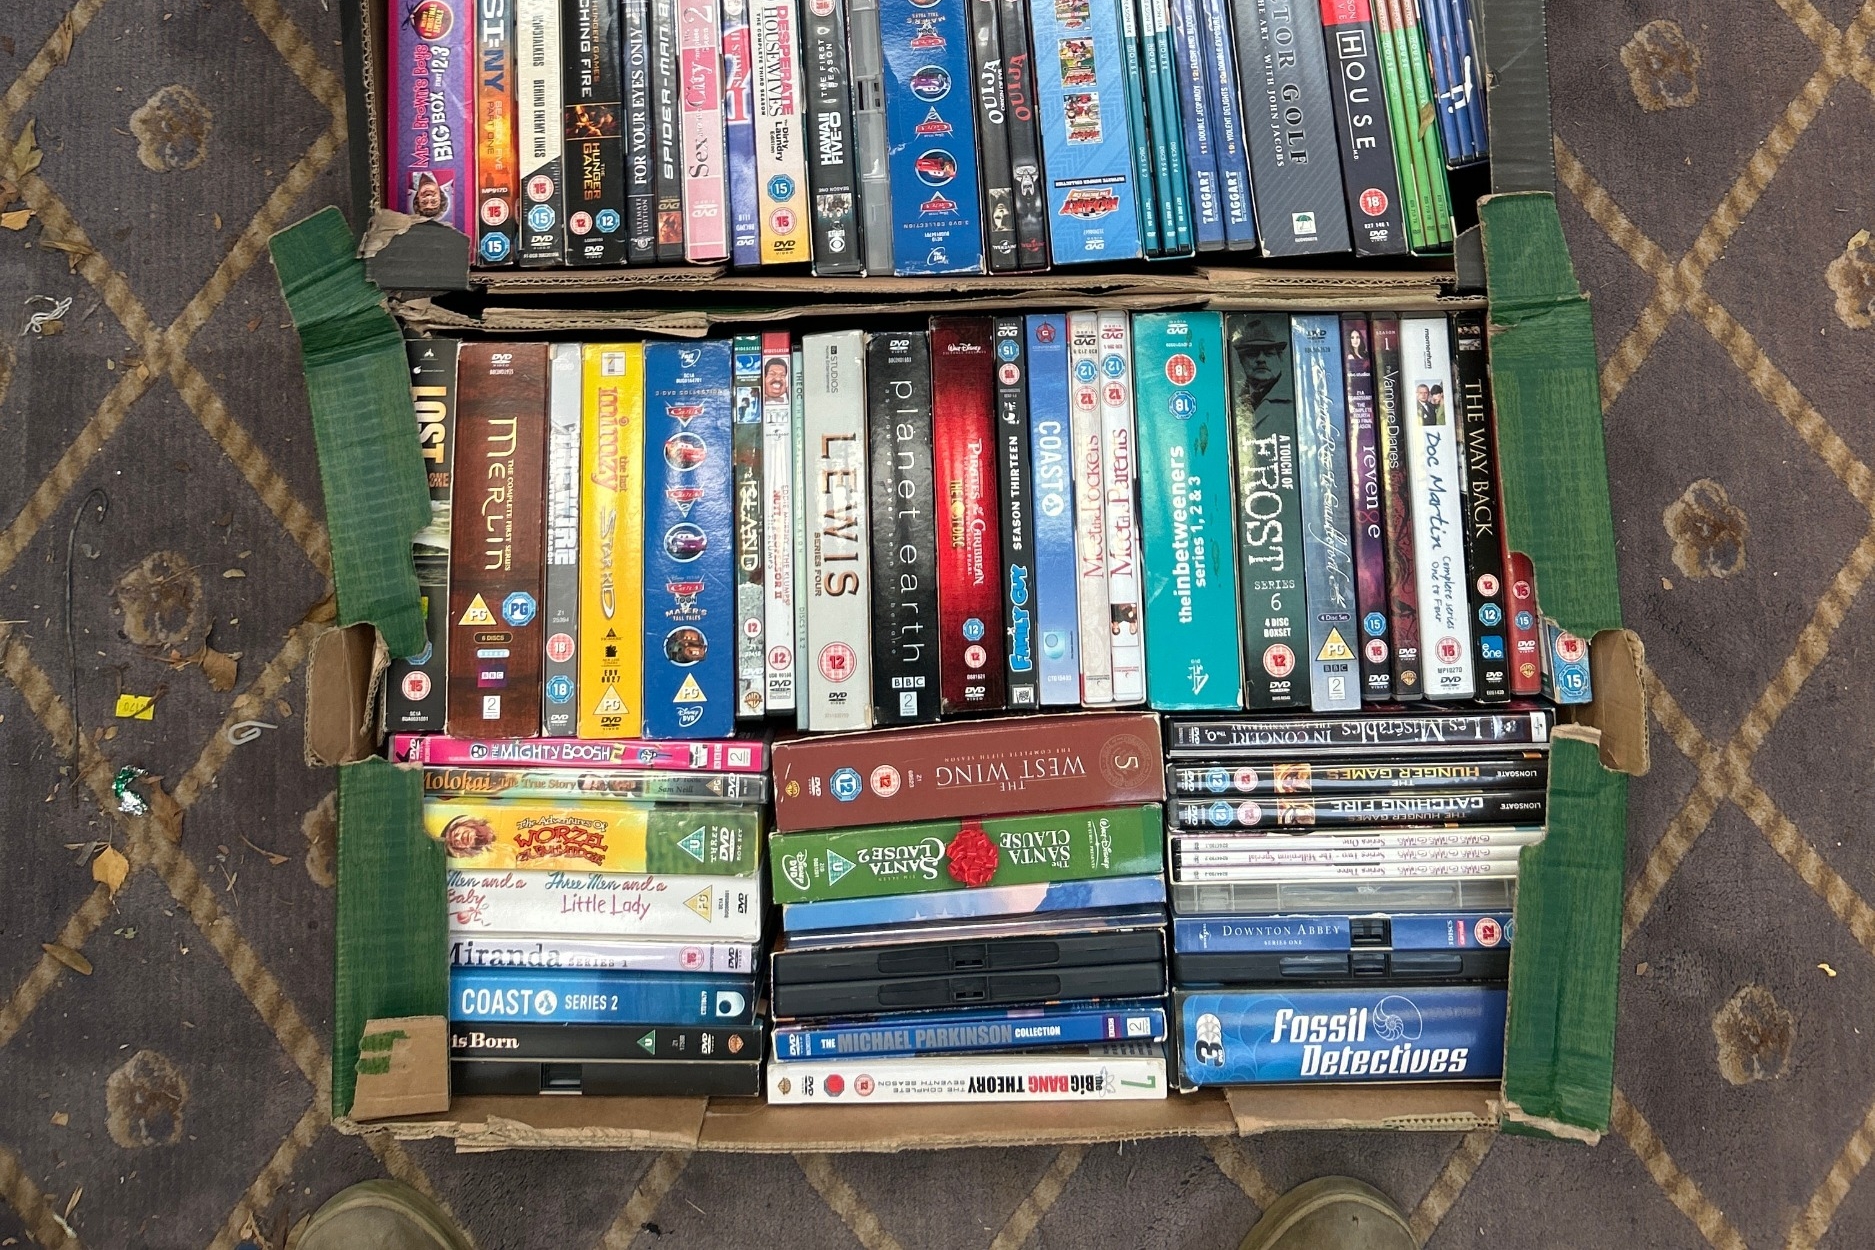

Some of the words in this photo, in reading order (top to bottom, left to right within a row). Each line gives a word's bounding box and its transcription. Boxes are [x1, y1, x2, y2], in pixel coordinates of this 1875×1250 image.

[631, 26, 645, 66] ONLY
[632, 27, 645, 61] ONLY
[776, 5, 794, 116] DESPERATE
[581, 58, 591, 98] FIRE
[763, 7, 781, 117] HOUSEWIVES
[532, 79, 545, 108] BEHIND
[632, 69, 646, 108] EYES
[979, 59, 1004, 124] OUIJA
[1006, 53, 1031, 121] OUIJA
[1336, 29, 1376, 150] HOUSE
[429, 91, 446, 124] BOX
[533, 110, 545, 134] ENEMY
[1281, 84, 1308, 165] GOLF
[430, 125, 454, 162] BIG
[533, 136, 545, 158] LINES
[633, 110, 647, 150] YOUR
[820, 113, 831, 166] HAWAII
[583, 142, 593, 200] GAMES
[590, 142, 600, 199] HUNGER
[634, 154, 647, 184] FOR
[689, 137, 710, 178] Sex
[1198, 170, 1214, 224] TAGGART
[1225, 170, 1242, 224] TAGGART
[1464, 379, 1483, 419] THE
[412, 386, 448, 464] LOST
[889, 379, 921, 520] planet
[1039, 421, 1064, 491] COAST
[1280, 442, 1293, 475] TOUCH
[1425, 432, 1442, 467] Doc
[1468, 424, 1487, 474] WAY
[1008, 435, 1021, 498] THIRTEEN
[820, 432, 859, 597] LEWIS
[1242, 433, 1285, 571] FROST
[1426, 475, 1444, 551] Martin
[1473, 478, 1493, 539] BACK
[1011, 500, 1023, 550] SEASON
[1169, 444, 1193, 624] theinbetweeners
[1009, 563, 1028, 605] GUY
[1254, 579, 1295, 590] SERIES
[898, 543, 925, 663] earth
[1270, 592, 1282, 611] 6
[1263, 628, 1292, 637] BOXSET
[1271, 617, 1289, 627] DISC
[1008, 608, 1033, 673] FAMILY
[892, 676, 925, 689] BBC
[562, 745, 611, 762] BOOSH
[1229, 731, 1315, 745] CONCERT
[1316, 732, 1331, 744] IN
[936, 761, 1007, 785] WING
[1018, 755, 1087, 775] WEST
[1327, 767, 1388, 780] GAMES
[1390, 765, 1479, 779] HUNGER
[1330, 800, 1378, 812] FIRE
[1381, 797, 1484, 811] CATCHING
[516, 817, 535, 831] The
[536, 815, 592, 830] Adventures
[1000, 829, 1072, 848] CLAUSE
[513, 827, 608, 855] WORZEL
[1009, 846, 1071, 863] SANTA
[545, 871, 586, 890] Three
[588, 871, 622, 889] Men
[622, 875, 654, 892] and
[656, 882, 668, 892] a
[560, 893, 607, 914] Little
[611, 893, 652, 920] Lady
[1222, 924, 1292, 937] DOWNTON
[1297, 923, 1340, 936] ABBEY
[461, 988, 533, 1015] COAST
[565, 995, 603, 1010] SERIES
[606, 995, 619, 1011] 2
[452, 1033, 468, 1049] is
[468, 1032, 520, 1049] Born
[821, 1039, 836, 1049] THE
[837, 1027, 914, 1054] MICHAEL
[915, 1024, 1013, 1048] PARKINSON
[1015, 1024, 1061, 1038] COLLECTION
[1270, 1007, 1369, 1044] Fossil
[1300, 1043, 1469, 1076] Detectives
[967, 1075, 1025, 1094] THEORY
[1028, 1074, 1069, 1094] BANG
